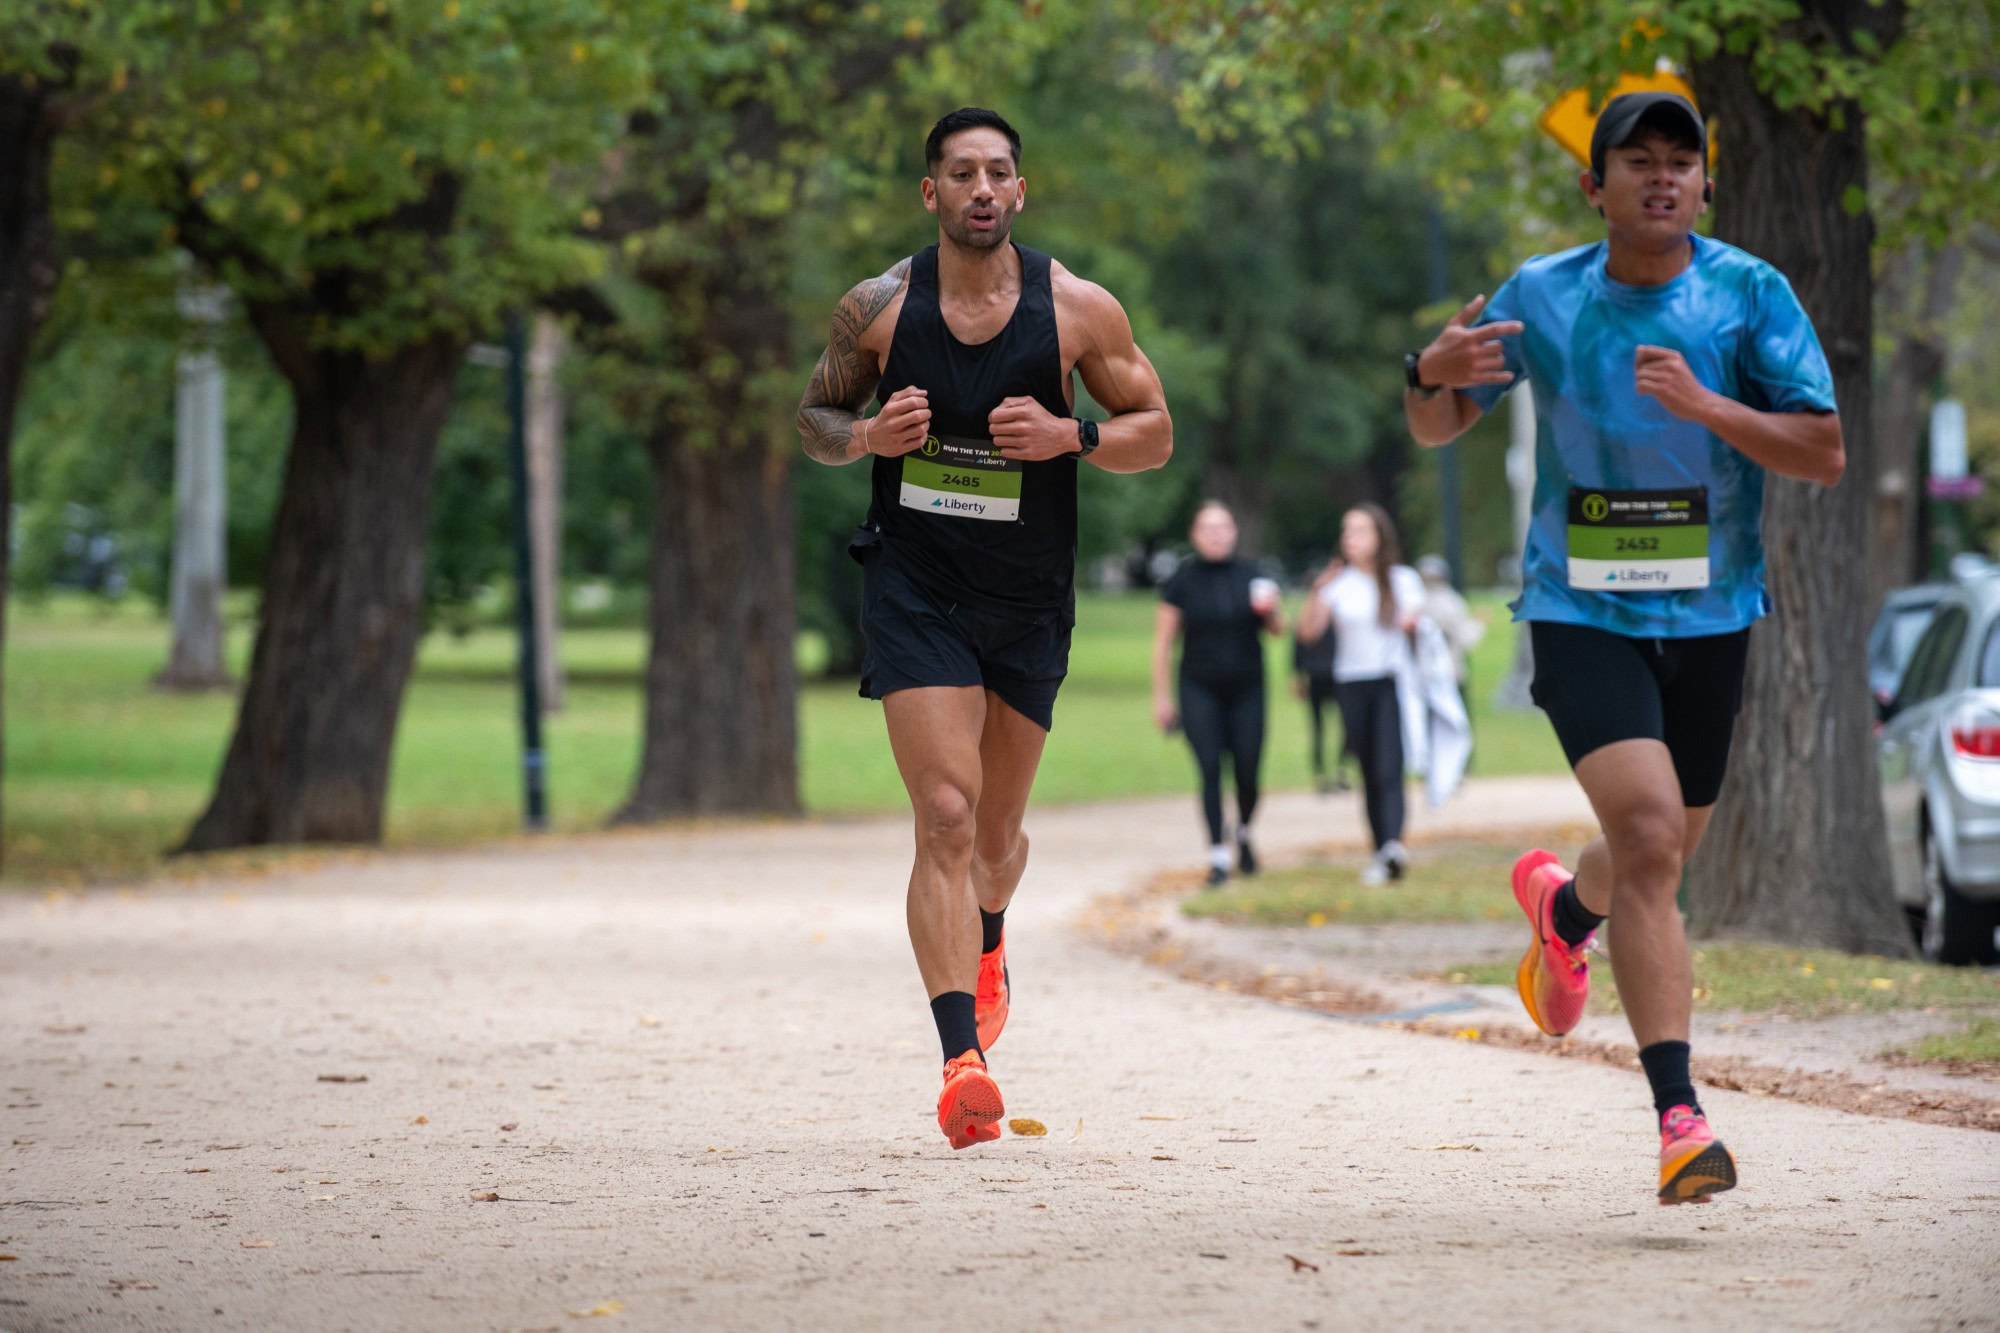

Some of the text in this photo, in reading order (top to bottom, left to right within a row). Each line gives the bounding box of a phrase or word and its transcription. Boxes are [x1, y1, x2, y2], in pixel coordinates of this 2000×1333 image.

[943, 444, 958, 453] RUN
[960, 447, 974, 455] THE
[983, 458, 1007, 466] Liberty
[942, 473, 980, 488] 2485
[944, 498, 986, 514] Liberty
[1616, 537, 1659, 552] 2452
[1620, 569, 1671, 583] Liberty
